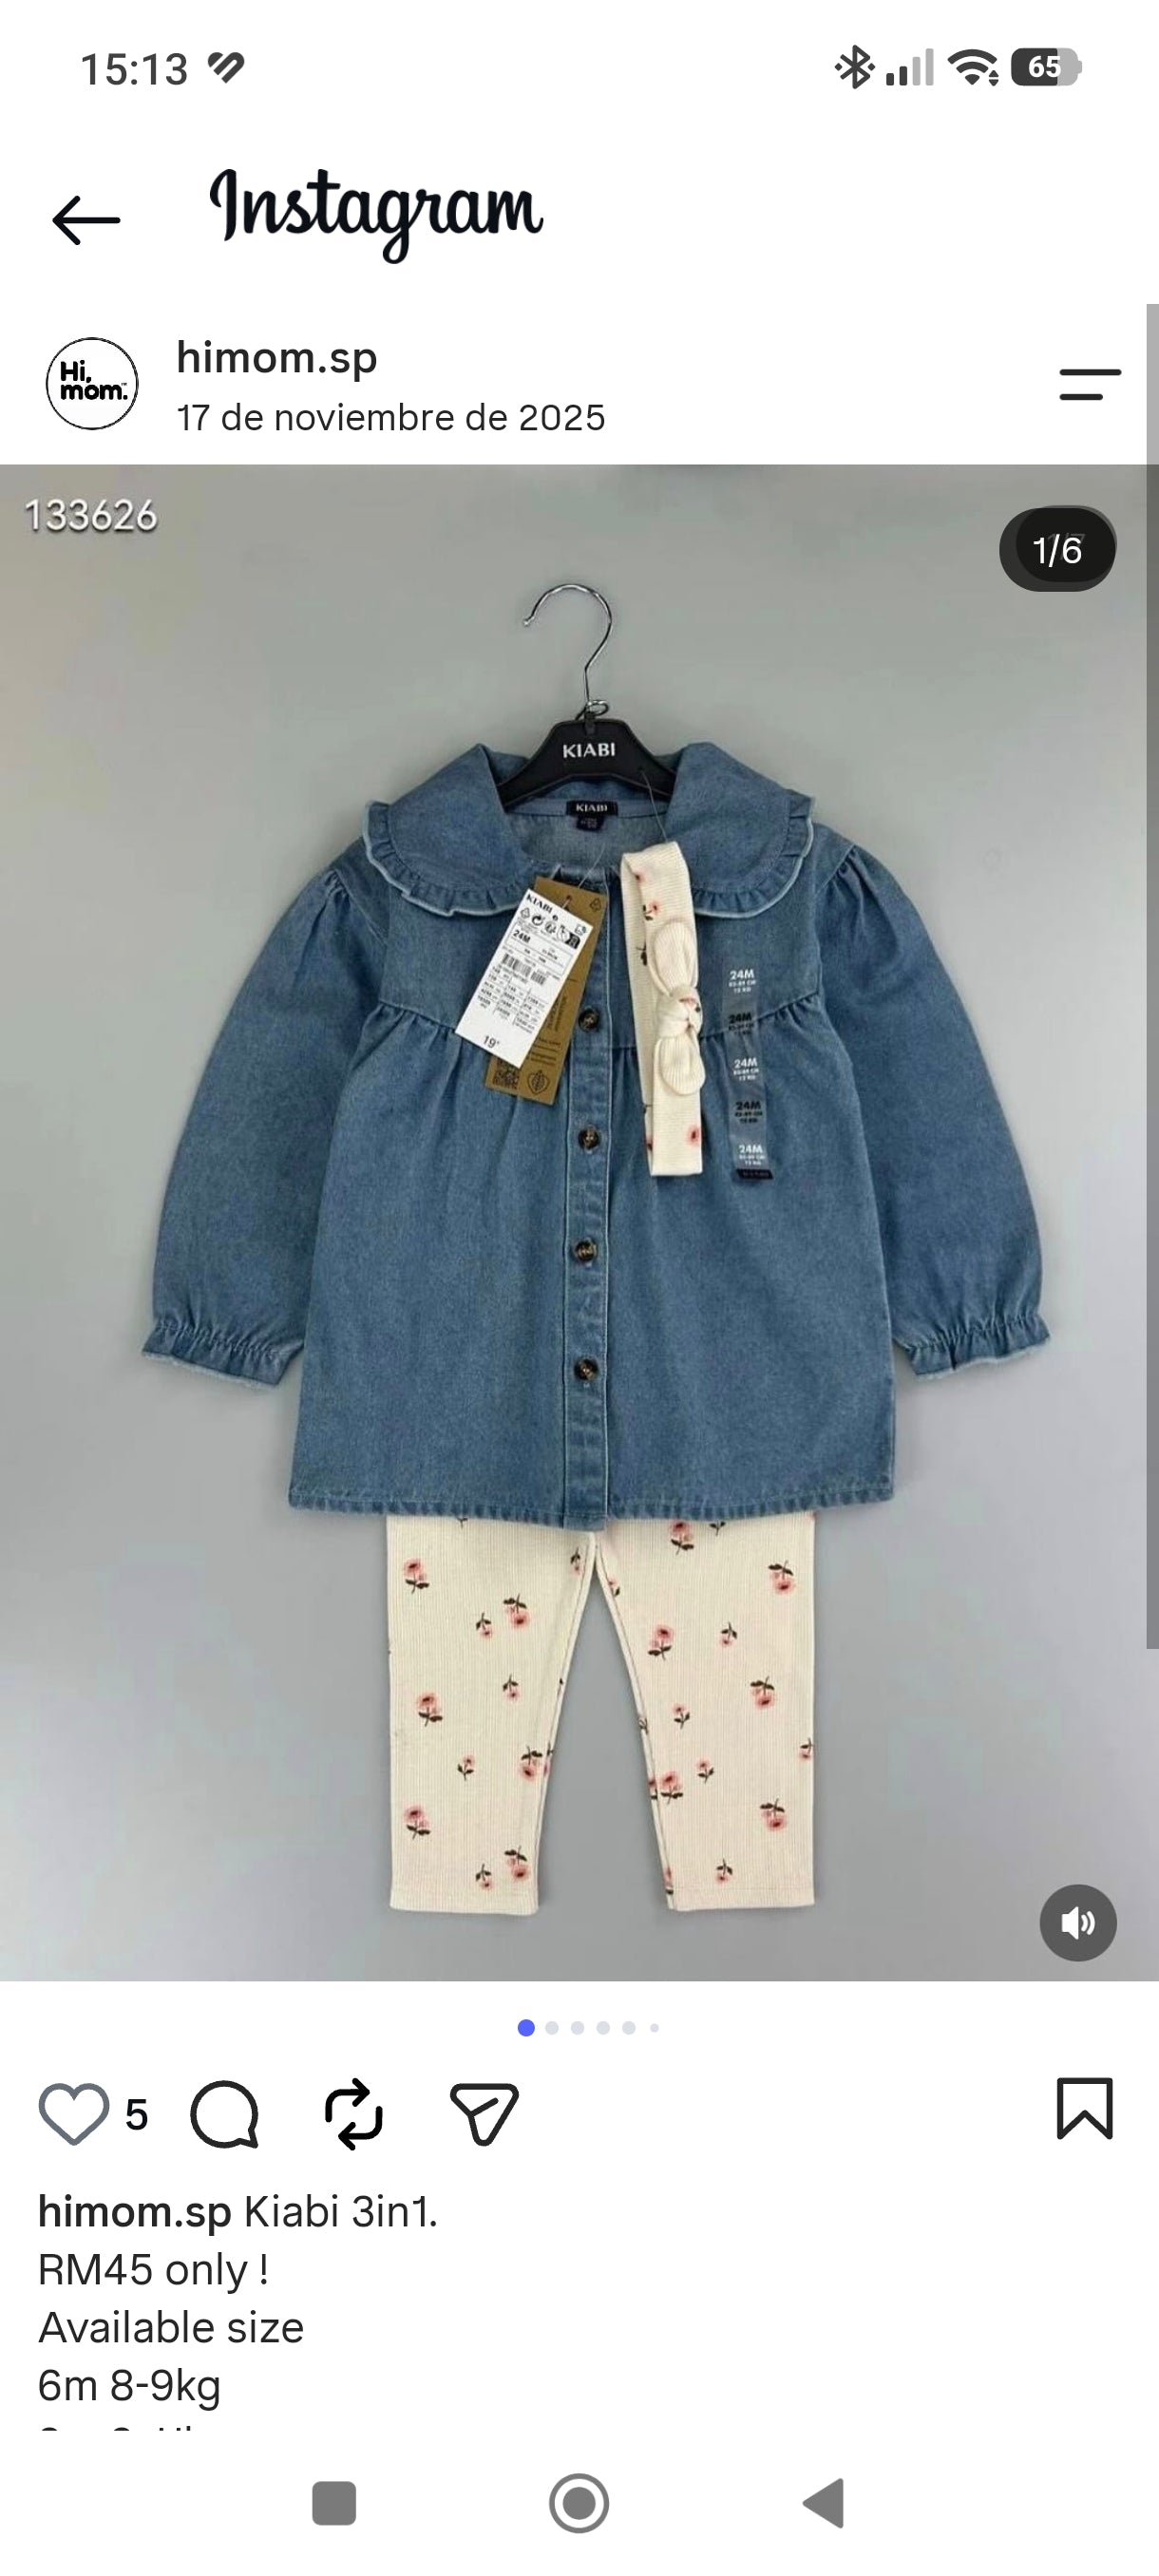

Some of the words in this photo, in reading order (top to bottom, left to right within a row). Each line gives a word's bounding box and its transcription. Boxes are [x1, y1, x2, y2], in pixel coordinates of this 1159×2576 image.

[82, 52, 188, 85] 15:13
[1028, 55, 1062, 78] 65
[209, 168, 544, 265] Instagram
[60, 359, 92, 384] Hi,
[178, 339, 377, 383] himom.sp
[60, 384, 128, 401] mom.
[177, 404, 210, 431] 17
[221, 402, 264, 431] de
[276, 402, 455, 431] noviembre
[466, 402, 508, 431] de
[519, 404, 605, 431] 2025
[562, 742, 616, 759] KIABI
[576, 803, 608, 813] KIABI
[526, 894, 553, 913] KIABI
[513, 929, 531, 943] 24M
[730, 968, 755, 980] 24M
[733, 1057, 758, 1069] 24M
[735, 1100, 762, 1110] 24M
[738, 1144, 764, 1154] 24M
[125, 2098, 148, 2131] 5
[39, 2193, 232, 2237] himom.sp
[246, 2193, 338, 2228] Kiabi
[352, 2193, 437, 2228] 3in1.
[40, 2253, 153, 2286] RM45
[165, 2251, 249, 2295] only
[259, 2253, 269, 2286] !
[37, 2309, 215, 2344] Available
[227, 2309, 304, 2344] size
[38, 2368, 97, 2402] 6m
[110, 2367, 219, 2412] 8-9kg
